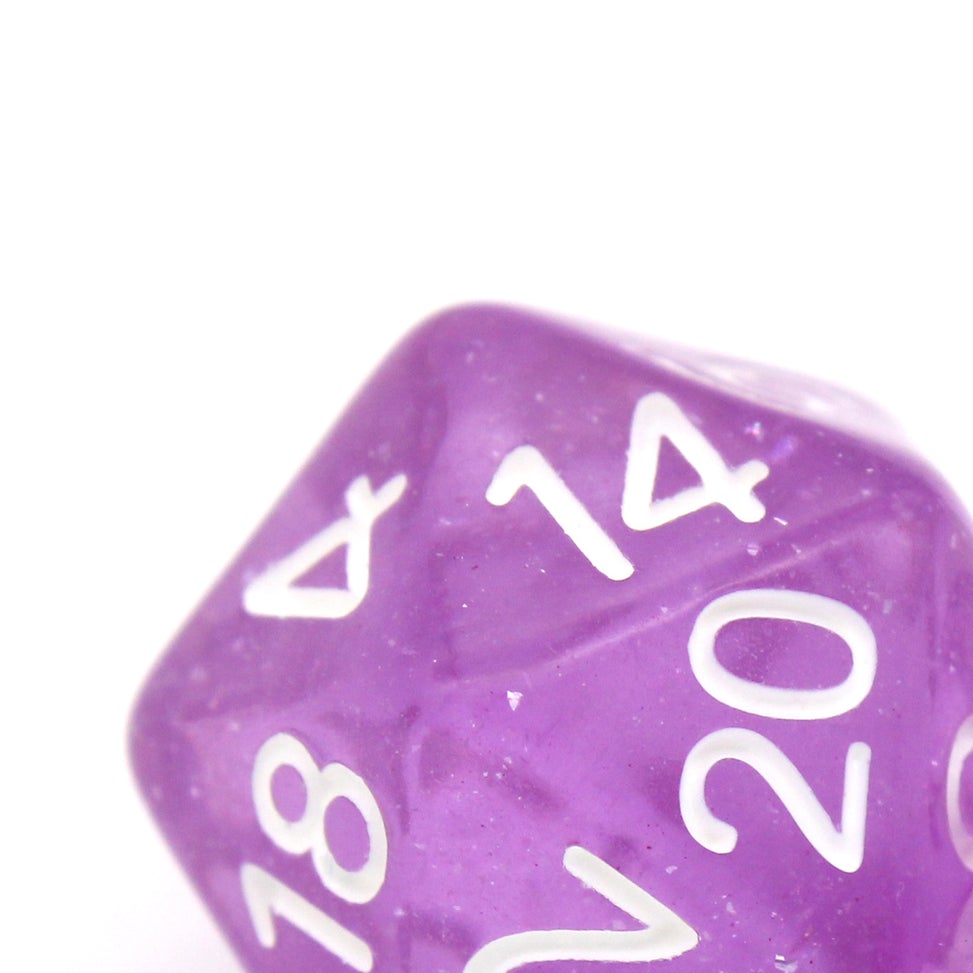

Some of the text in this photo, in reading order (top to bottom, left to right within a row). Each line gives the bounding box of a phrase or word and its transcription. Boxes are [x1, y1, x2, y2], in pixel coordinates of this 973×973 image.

[243, 473, 408, 620] 4
[485, 391, 771, 581] 14
[678, 588, 878, 873] 20
[240, 731, 390, 973] 18
